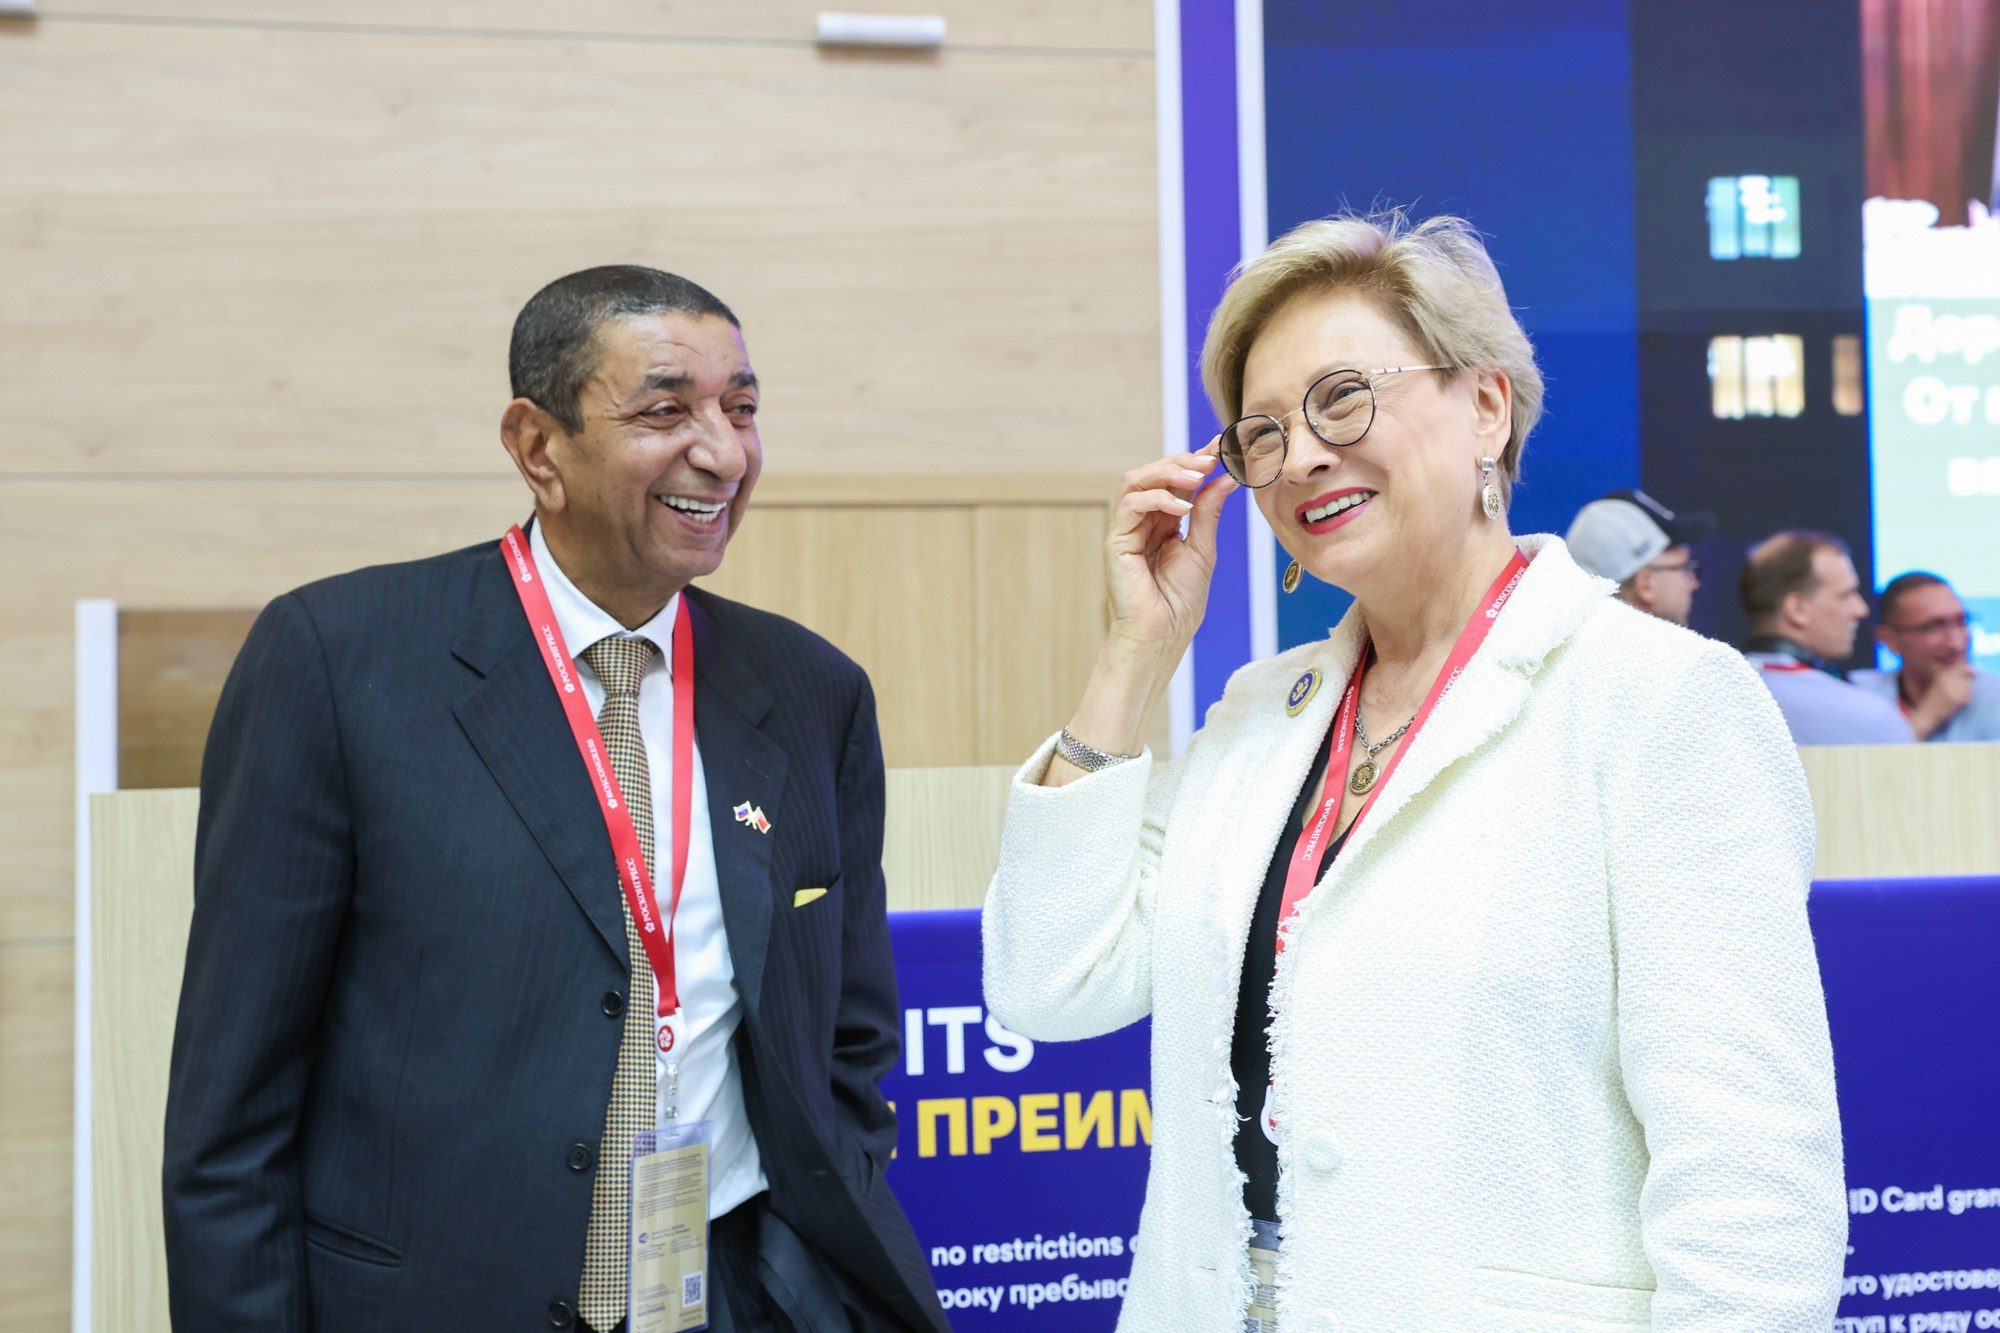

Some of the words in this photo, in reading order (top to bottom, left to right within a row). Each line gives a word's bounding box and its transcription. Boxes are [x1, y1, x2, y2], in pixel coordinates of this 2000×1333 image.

[586, 738, 615, 799] ROSCONGRESS
[1302, 806, 1331, 861] РОСКОНГРЕСС
[625, 857, 652, 923] РОСКОНГРЕСС
[904, 1005, 1035, 1076] ITS
[1849, 1187, 1879, 1215] ID
[1881, 1183, 1944, 1213] Card
[931, 1244, 967, 1267] no
[972, 1231, 1124, 1264] restrictions
[1879, 1268, 2000, 1300] удостове
[1889, 1314, 1907, 1333] к
